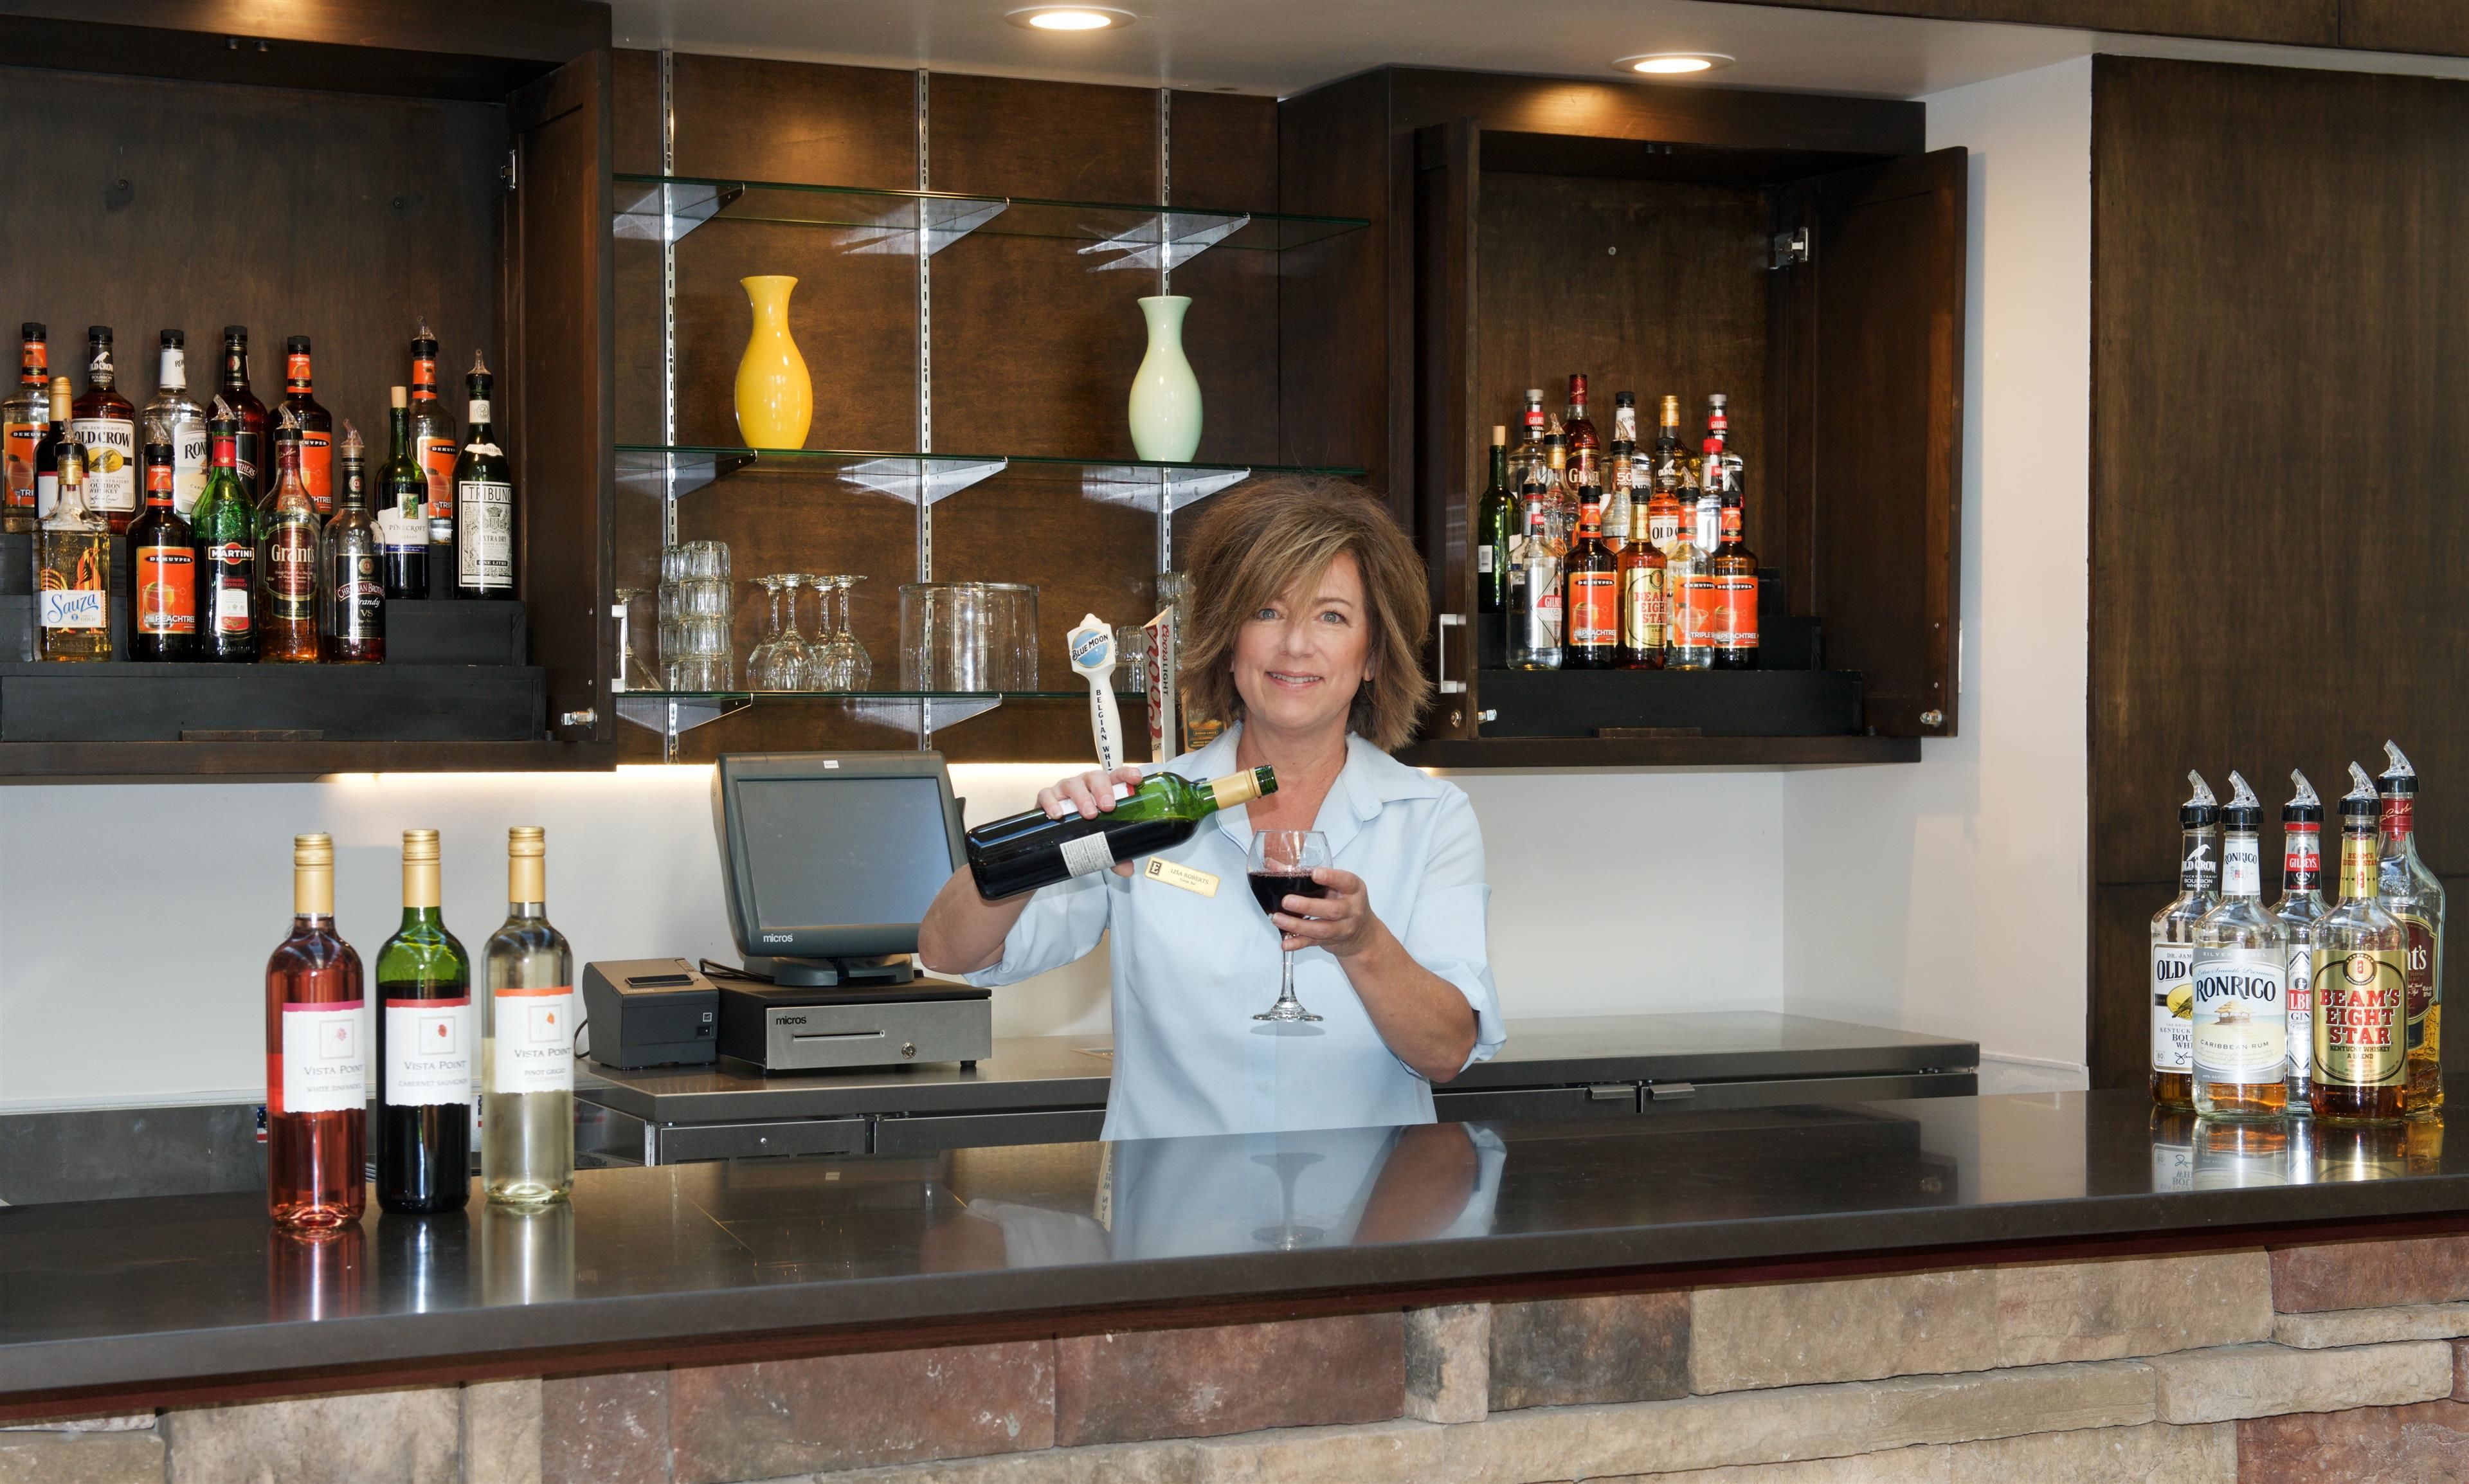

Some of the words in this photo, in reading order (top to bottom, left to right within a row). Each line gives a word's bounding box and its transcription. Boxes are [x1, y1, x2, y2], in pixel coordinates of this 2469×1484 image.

[75, 431, 96, 444] OLD
[98, 431, 131, 448] CROW
[235, 460, 256, 476] OTHERS
[1617, 472, 1632, 482] 50
[389, 524, 426, 533] PINECROFT
[212, 549, 252, 557] MARTINI
[271, 545, 314, 563] Grant's
[337, 583, 368, 599] CHRIAN
[368, 583, 385, 598] BROTHE
[1634, 592, 1667, 602] BEAM
[47, 593, 99, 624] Sauza
[357, 597, 380, 608] randy
[1641, 602, 1667, 613] EIGH
[156, 615, 195, 623] PEACHTREE
[1072, 644, 1088, 661] BLUE
[1089, 634, 1108, 649] MOON
[1096, 689, 1107, 741] BELGIAN
[1103, 745, 1113, 771] WHI
[2225, 852, 2257, 865] RONRICO
[2290, 858, 2317, 869] GILBEY'S
[2194, 860, 2216, 873] CROW
[1170, 869, 1183, 877] LISA
[1184, 873, 1209, 885] ROBERTS
[763, 934, 793, 943] micros
[2408, 945, 2427, 972] nt's
[2157, 959, 2186, 981] OLD
[2196, 976, 2276, 1002] RONRICO
[2320, 988, 2401, 1008] BEAM'S
[775, 1016, 807, 1025] micros
[2326, 1008, 2394, 1027] EIGHT
[2200, 1039, 2248, 1050] CARIBBEAN
[514, 1049, 545, 1058] VISTA
[548, 1047, 572, 1057] POINT
[303, 1067, 336, 1076] VISTA
[404, 1062, 436, 1071] VISTA
[439, 1060, 467, 1069] POINT
